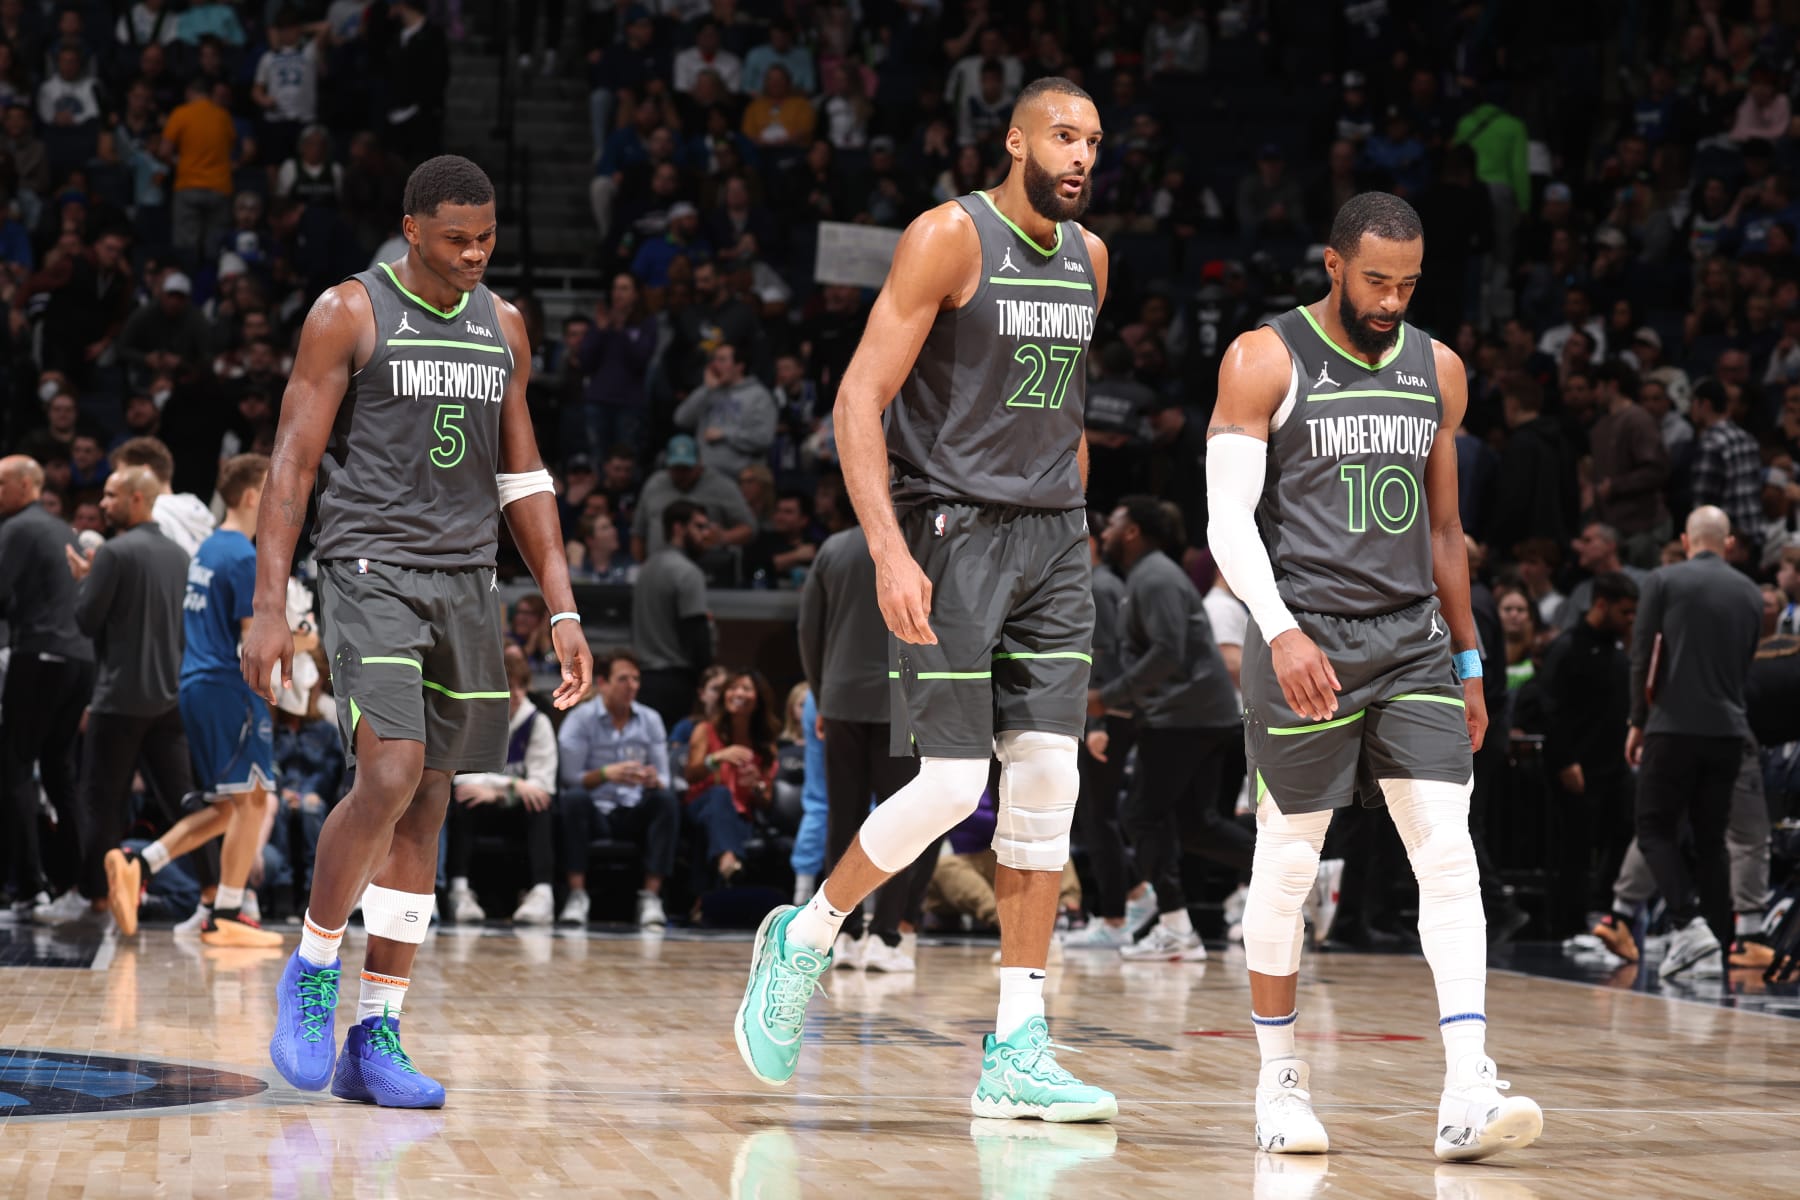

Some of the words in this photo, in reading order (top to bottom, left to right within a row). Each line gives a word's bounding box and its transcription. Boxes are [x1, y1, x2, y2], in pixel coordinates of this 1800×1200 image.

[996, 299, 1094, 345] TIMBERWOLVES
[389, 360, 506, 406] TIMBERWOLVES
[1006, 343, 1082, 409] 27
[430, 404, 466, 468] 5
[1340, 464, 1419, 534] 10
[404, 911, 419, 923] 5
